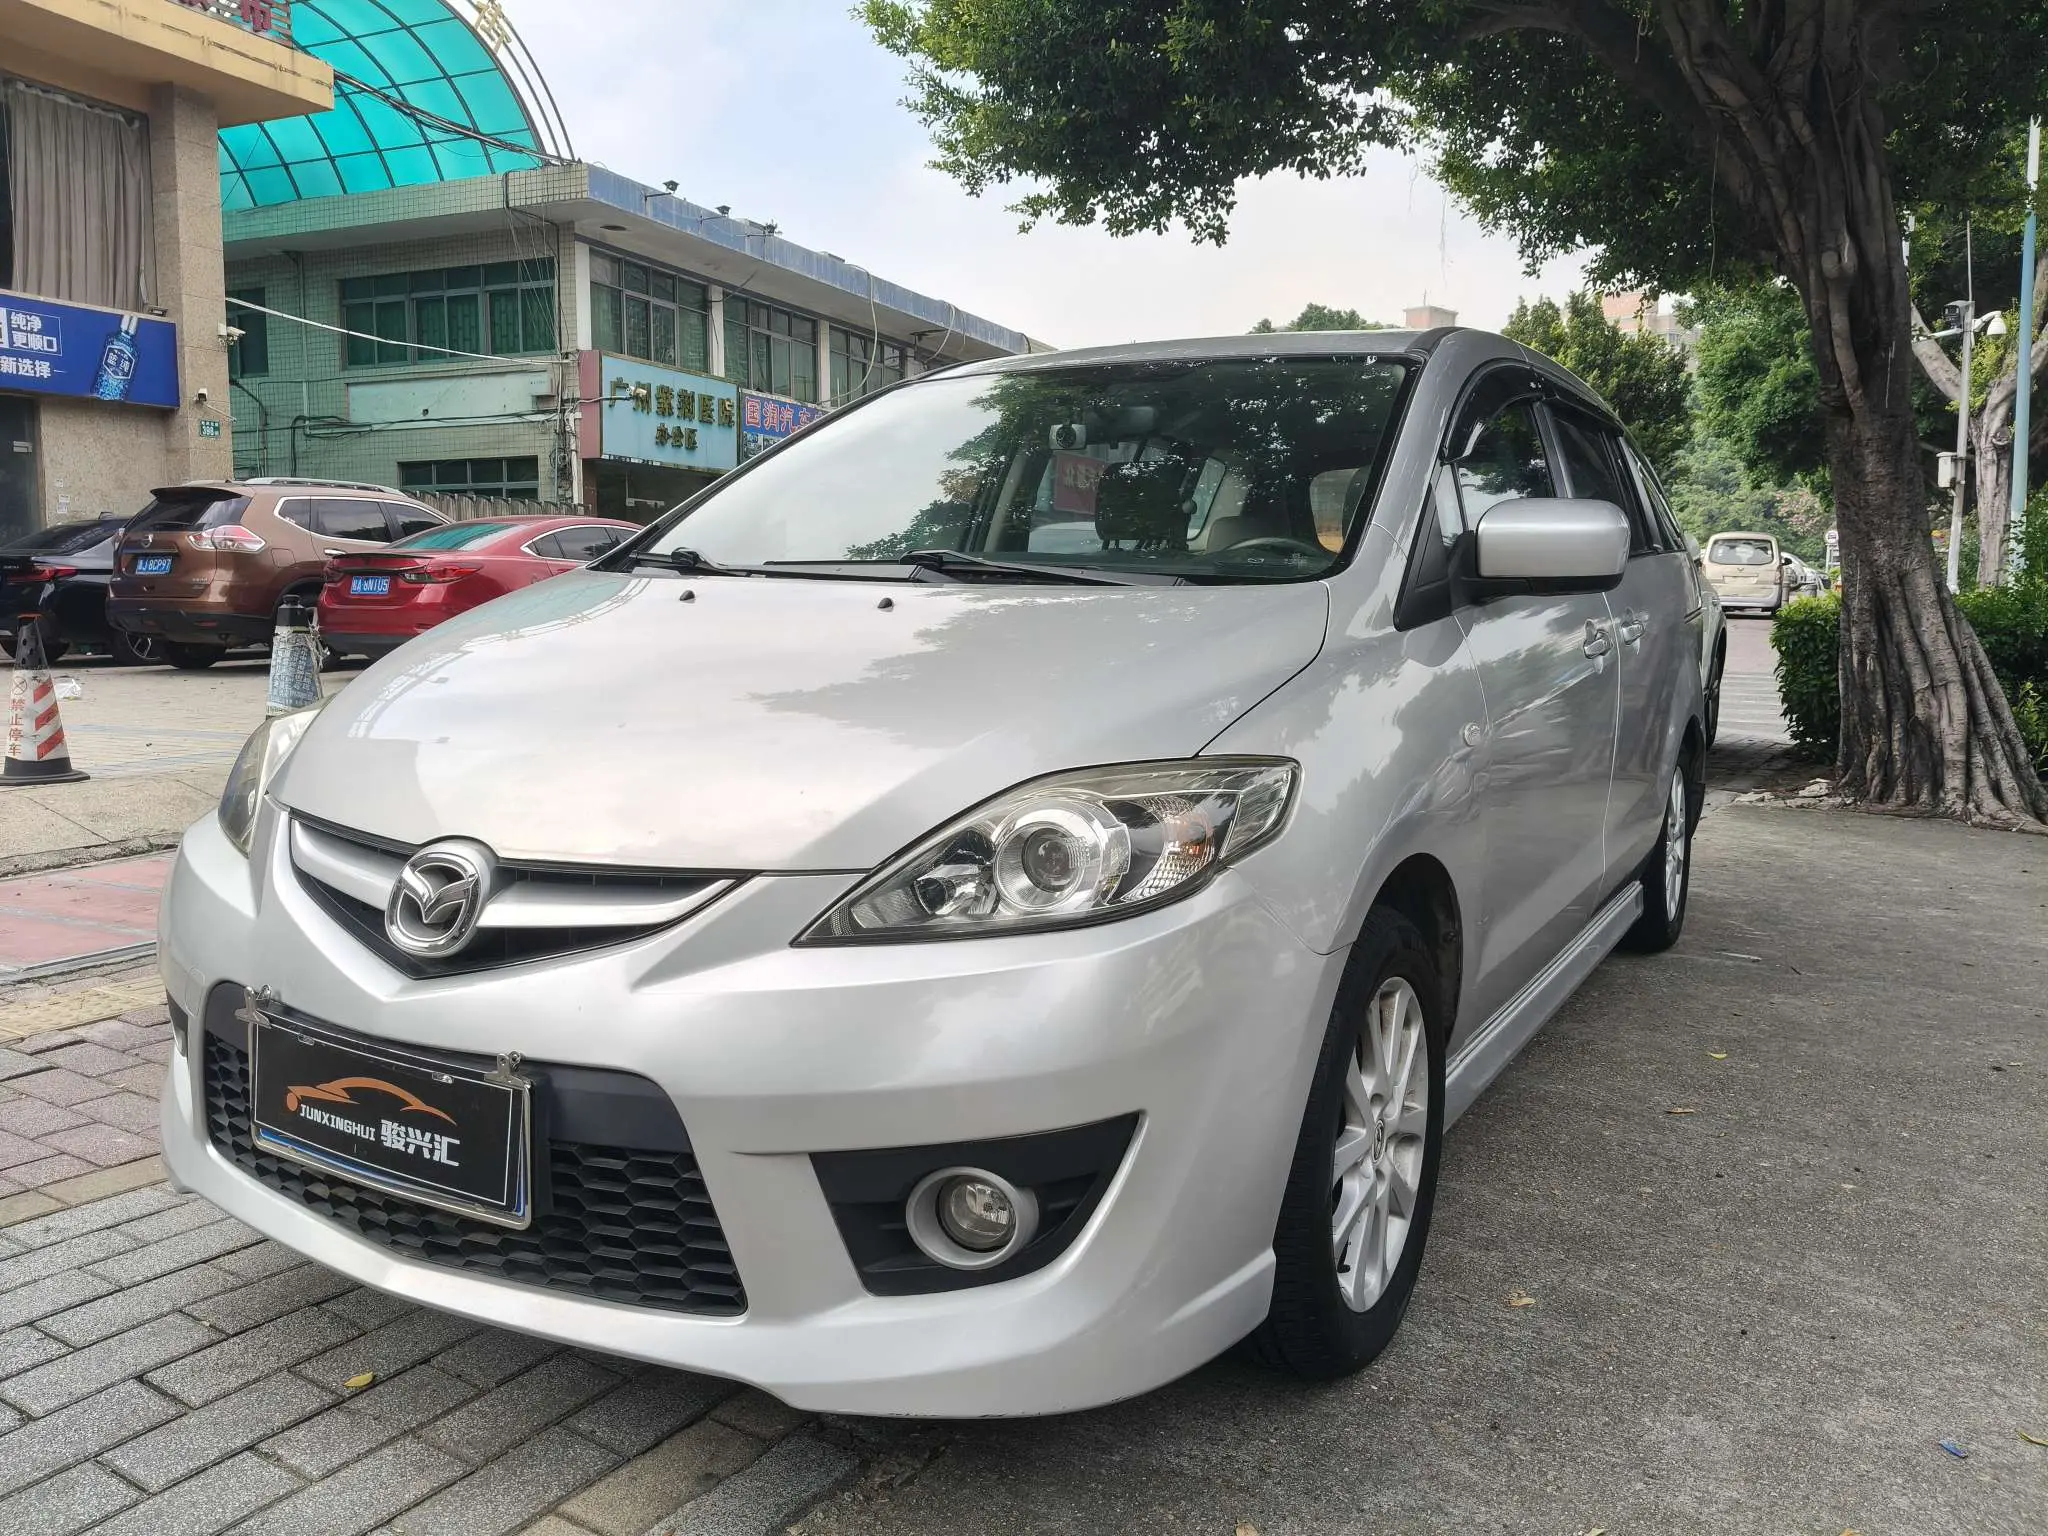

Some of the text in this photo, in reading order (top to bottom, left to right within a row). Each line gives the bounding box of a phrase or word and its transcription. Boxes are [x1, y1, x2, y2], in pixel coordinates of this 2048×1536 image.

[11, 312, 42, 332] 纯净
[12, 331, 58, 352] 更顺口
[0, 355, 52, 379] 新选择
[745, 396, 824, 434] 国润汽车
[655, 422, 699, 450] 办公区
[8, 699, 26, 757] 禁止停车
[300, 1103, 461, 1167] JUNXINGHUI 骏兴汇
